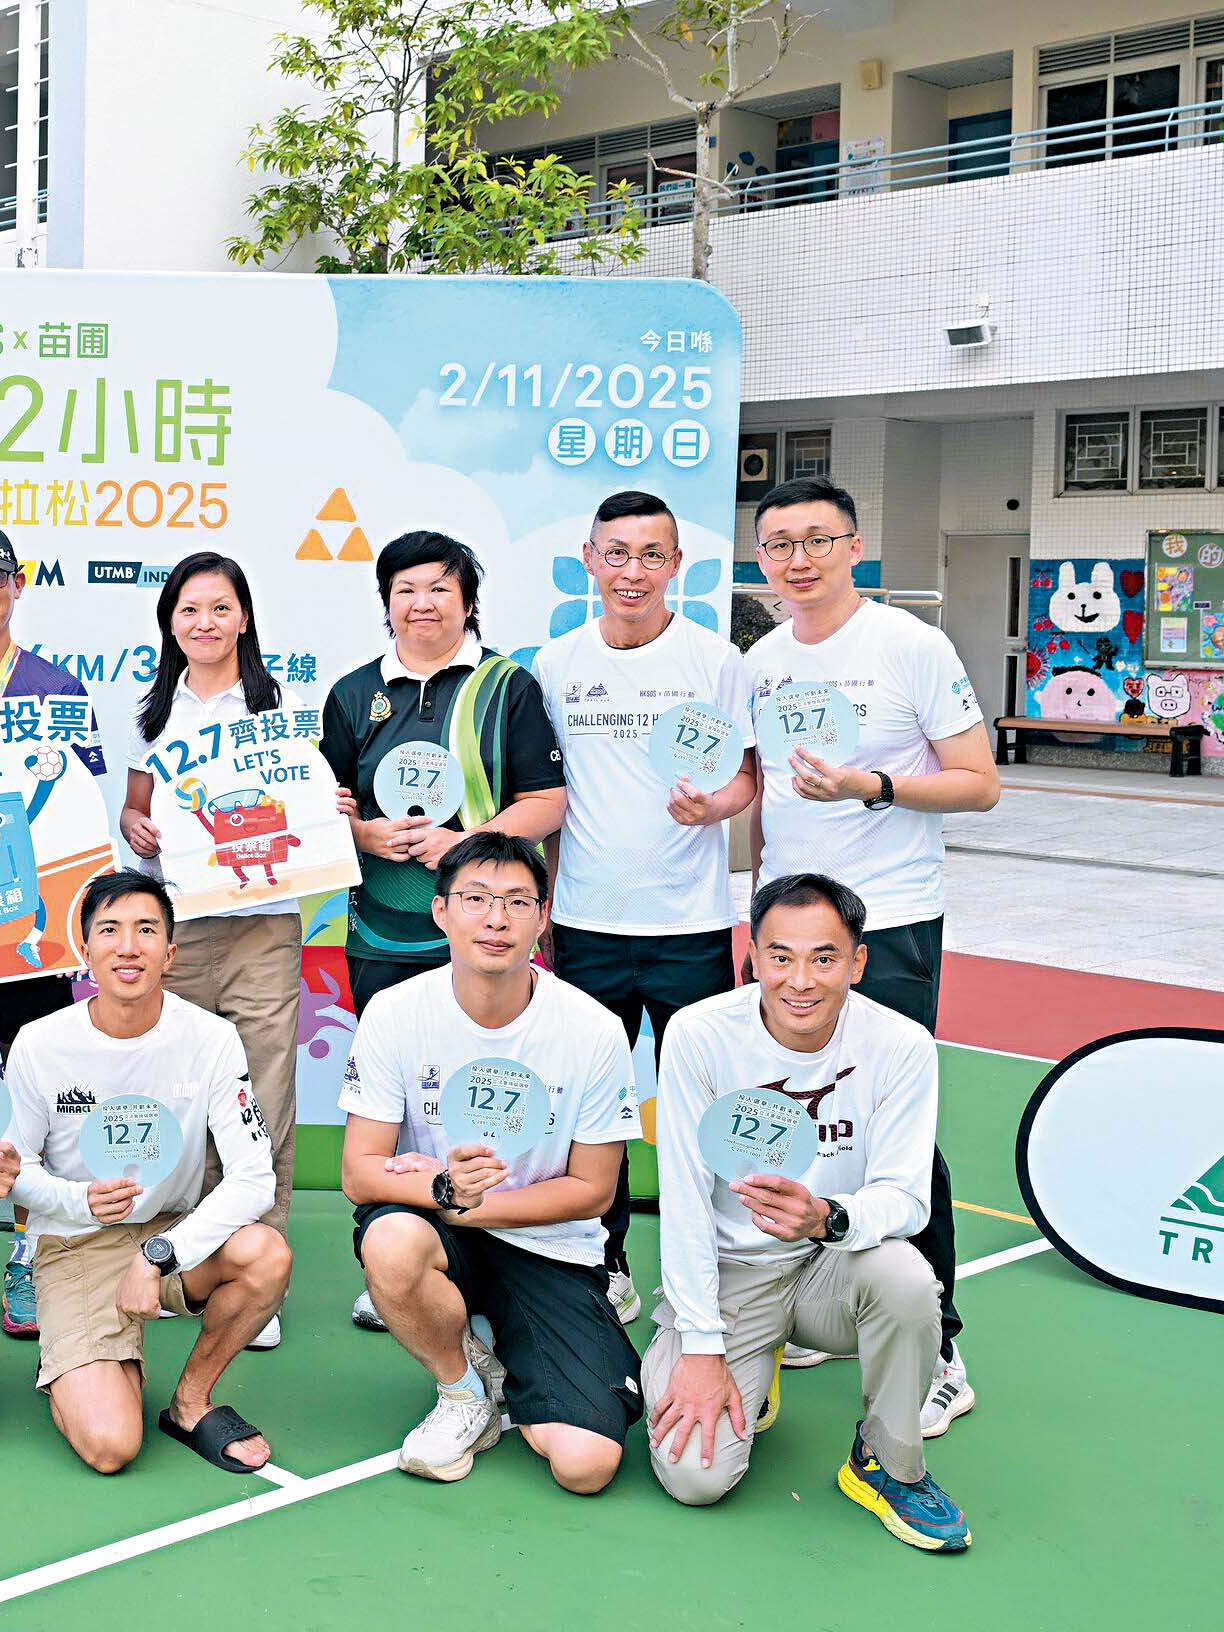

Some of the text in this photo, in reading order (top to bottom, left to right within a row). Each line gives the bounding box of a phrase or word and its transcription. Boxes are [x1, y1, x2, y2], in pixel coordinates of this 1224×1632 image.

[38, 321, 109, 359] 苗圃
[640, 330, 713, 354] 今日喺
[439, 363, 712, 409] 2/11/2025
[554, 423, 703, 462] 星期日
[94, 566, 168, 583] UTMB IND
[778, 703, 798, 712] 2025
[567, 713, 662, 727] CHALLENGING 12 H
[680, 715, 700, 727] 2025
[779, 712, 807, 734] 12
[613, 729, 638, 738] 2025
[675, 724, 700, 750] 12
[146, 709, 320, 784] 12.7 齊投票
[233, 749, 282, 773] LET'S
[398, 758, 417, 766] 2025
[260, 765, 310, 785] VOTE
[396, 766, 420, 788] 12
[3, 905, 19, 914] Box
[470, 1076, 492, 1085] 2025
[423, 1101, 440, 1116] CH
[468, 1085, 495, 1110] 12
[103, 1114, 124, 1122] 2025
[735, 1103, 759, 1116] 2025
[103, 1123, 130, 1145] 12
[731, 1114, 760, 1140] 12
[1159, 1230, 1214, 1264] TR
